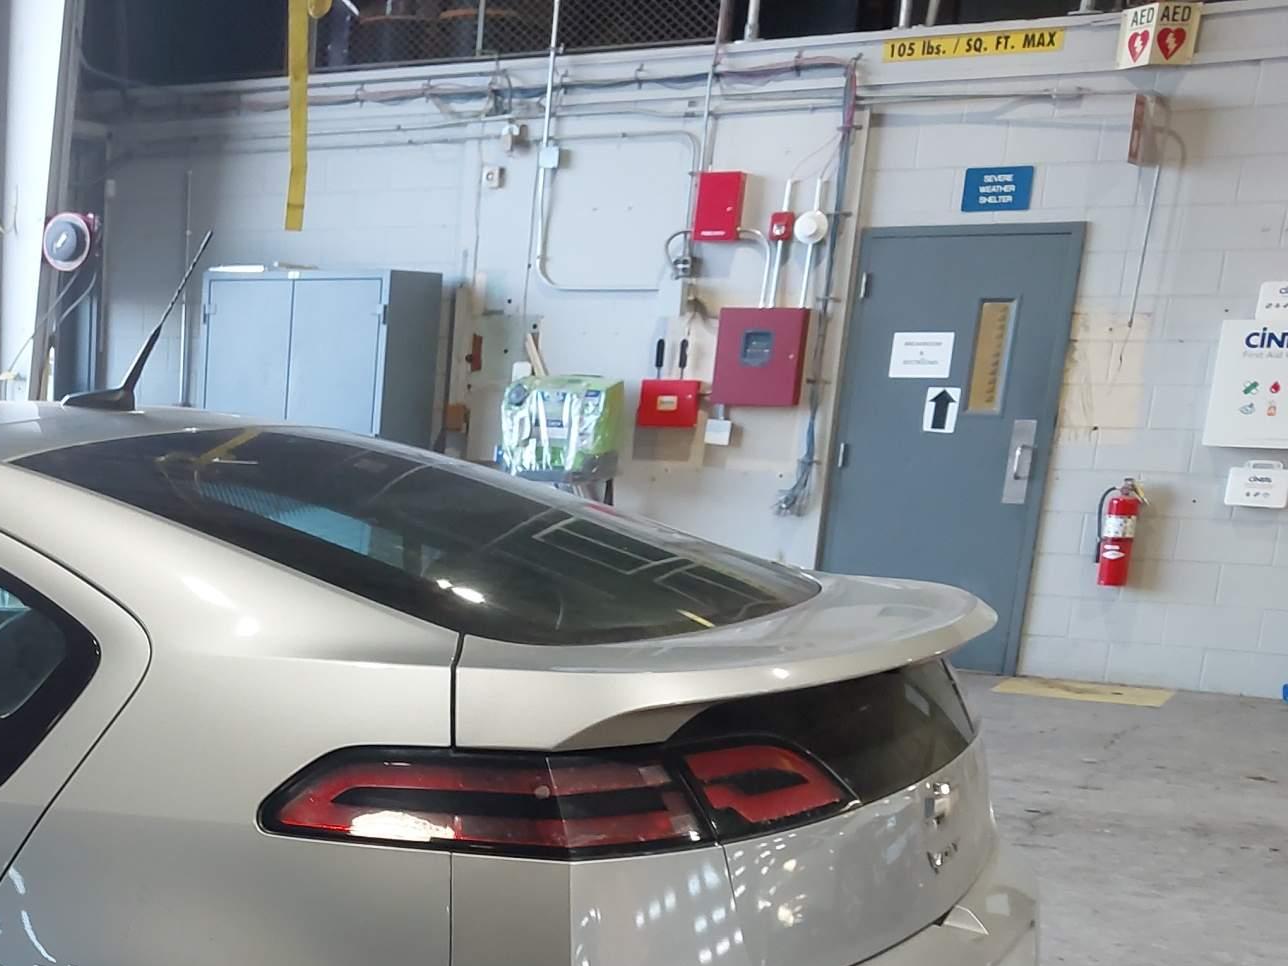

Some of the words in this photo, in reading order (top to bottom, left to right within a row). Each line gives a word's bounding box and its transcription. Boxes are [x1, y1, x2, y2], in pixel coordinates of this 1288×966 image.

[1131, 7, 1155, 27] AED
[1160, 5, 1192, 22] AED
[890, 42, 915, 58] 105
[921, 40, 946, 56] lbs.
[952, 38, 960, 55] /
[965, 37, 988, 54] SQ.
[995, 35, 1015, 51] FT.
[1022, 31, 1057, 49] MAX
[983, 174, 1014, 183] SEVERE
[978, 184, 1016, 193] WEATHER
[978, 195, 1013, 204] SHELTER
